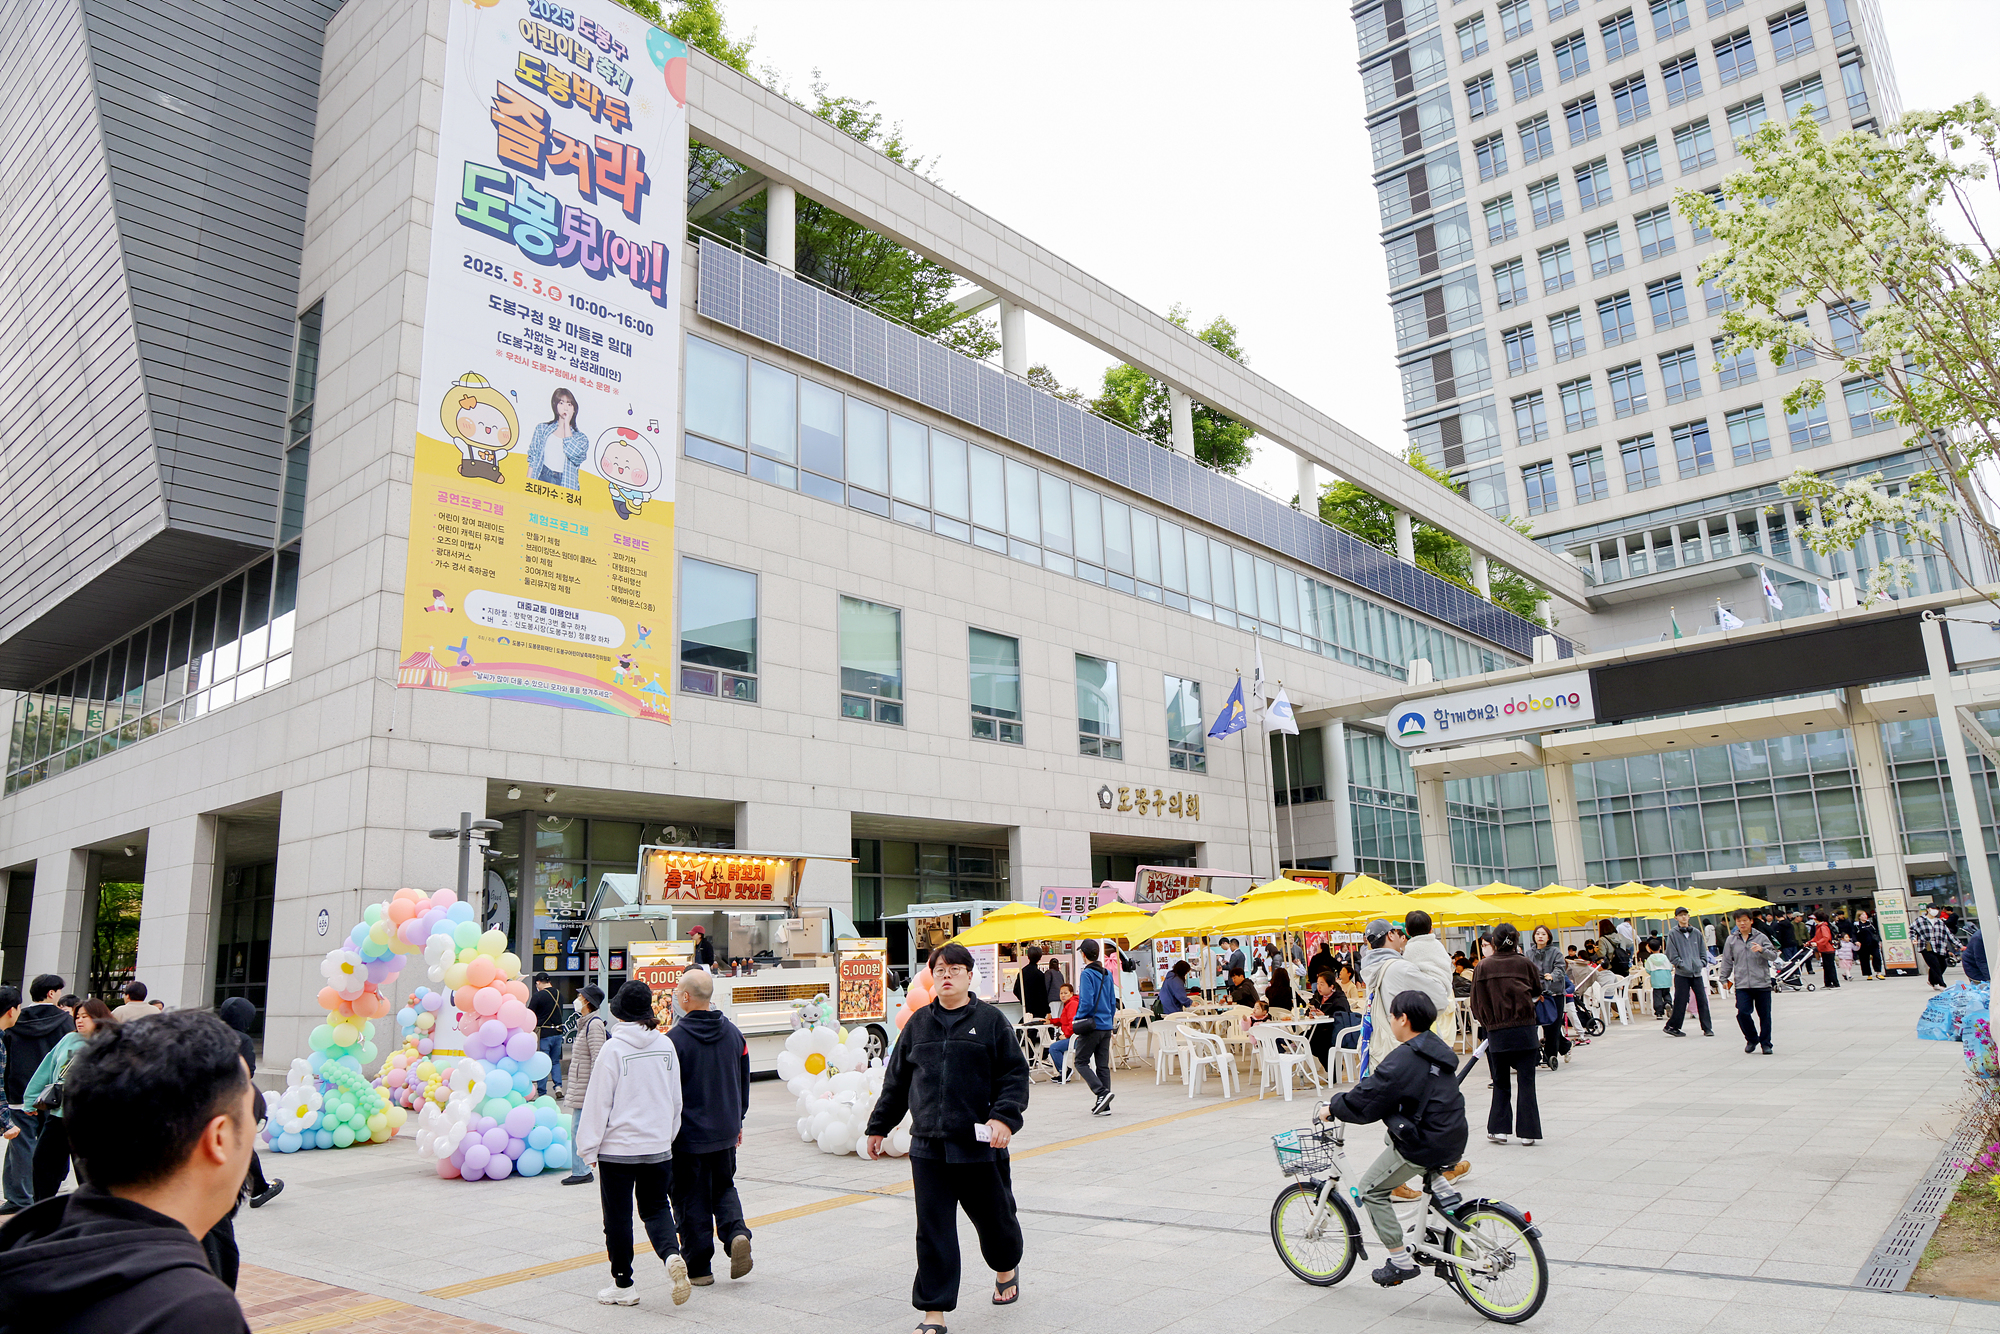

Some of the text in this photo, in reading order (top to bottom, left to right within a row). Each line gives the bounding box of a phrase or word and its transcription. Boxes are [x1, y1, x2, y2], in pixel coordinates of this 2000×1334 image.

[527, 0, 628, 61] 2025 도봉구
[518, 19, 633, 96] 어린이날 축제
[515, 51, 633, 134] 도봉박두
[490, 80, 650, 225] 즐겨라
[463, 254, 508, 282] 2025.
[568, 293, 654, 336] 10:00~16:00
[488, 294, 632, 358] 도봉구청 앞 마들로 일대
[523, 327, 600, 362] 차없는 거리 운영
[497, 331, 544, 356] (도봉구청
[547, 347, 558, 361] 앞
[570, 356, 622, 382] 삼성래미안)
[505, 352, 611, 393] 우천시 도봉구청에서 축소 운영
[437, 490, 504, 516] 공연프로그램
[525, 482, 558, 500] 초대가수
[566, 492, 582, 506] 경서
[438, 512, 505, 534] 어린이 참여 퍼레이드
[528, 512, 589, 537] 체험프로그램
[437, 524, 505, 545] 어린이 캐릭터 뮤지컬
[437, 536, 482, 552] 오즈의 마법사
[526, 531, 560, 547] 만들기 체험
[613, 533, 650, 552] 도봉랜드
[436, 547, 472, 561] 광대서커스
[525, 554, 553, 568] 놀이 체험
[612, 552, 636, 564] 꼬마기차
[435, 559, 496, 579] 가수 경서 축하공연
[524, 566, 581, 585] 30여개의 체험부스
[558, 584, 571, 595] 체험
[611, 584, 641, 598] 대형바이킹
[488, 607, 508, 618] 지하철
[513, 612, 533, 622] 방학역
[517, 600, 580, 620] 대중교통 이용안내
[1434, 692, 1581, 730] 함께해요! dobong
[1117, 786, 1201, 822] 도봉구의회
[728, 864, 765, 881] 닭꼬치
[546, 886, 573, 899] 온라인
[704, 883, 773, 900] 진짜 맛있음
[1802, 883, 1853, 897] 도봉구청
[545, 901, 587, 916] 도봉구
[1060, 896, 1099, 913] 드링킹
[843, 963, 880, 977] 5,000원
